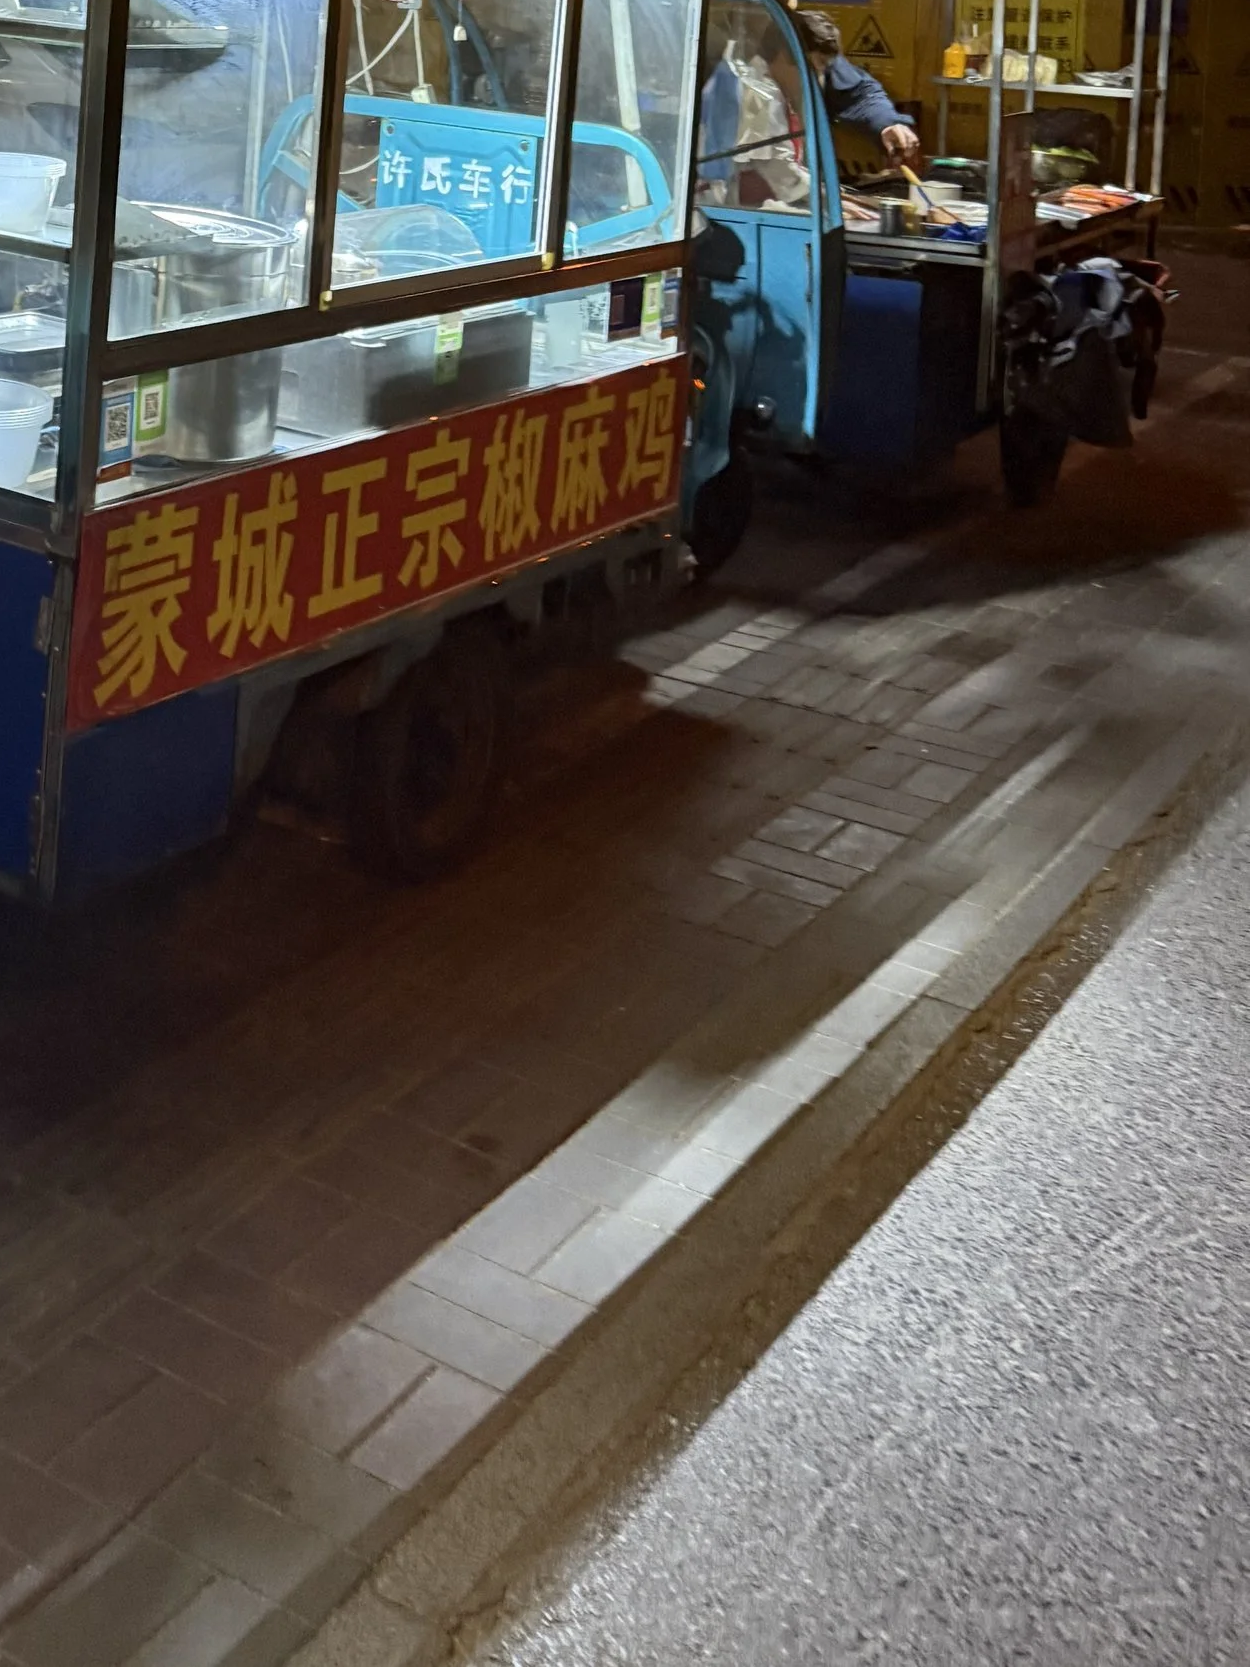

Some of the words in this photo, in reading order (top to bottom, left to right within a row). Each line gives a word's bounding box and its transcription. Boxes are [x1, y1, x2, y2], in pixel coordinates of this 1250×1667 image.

[381, 149, 533, 205] 许氏车行
[94, 369, 676, 708] 蒙城正宗椒麻鸡
